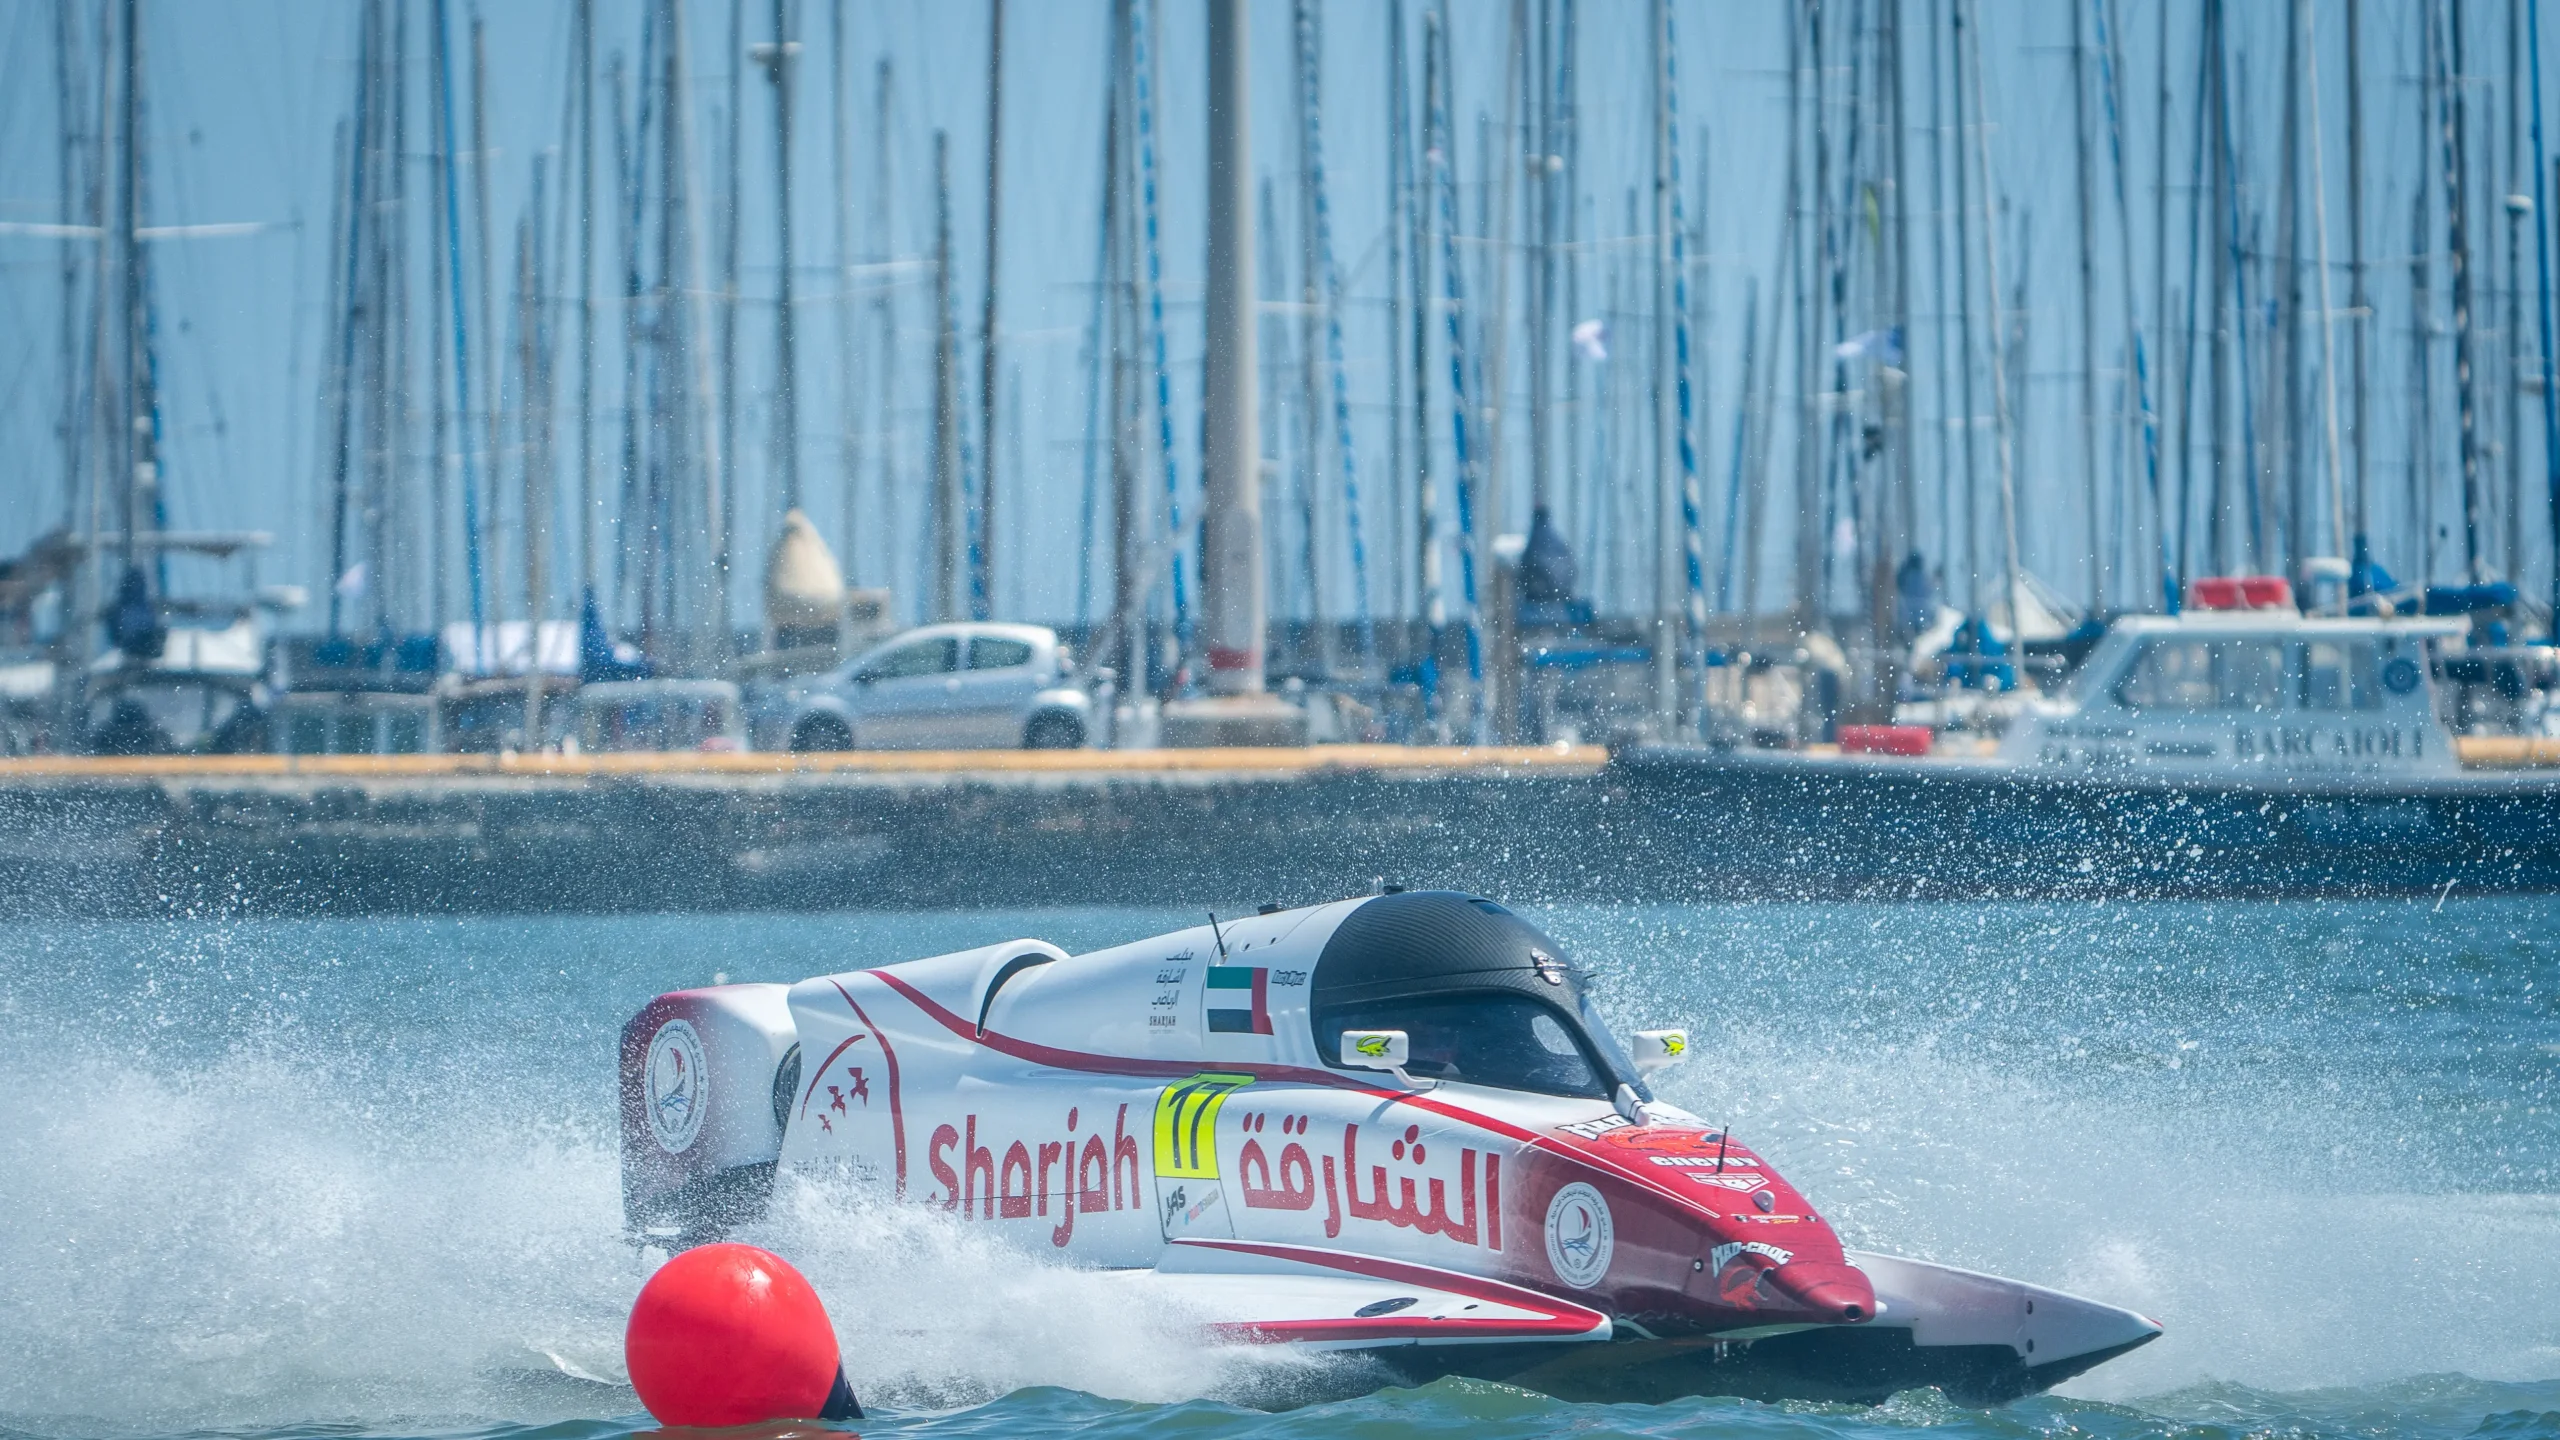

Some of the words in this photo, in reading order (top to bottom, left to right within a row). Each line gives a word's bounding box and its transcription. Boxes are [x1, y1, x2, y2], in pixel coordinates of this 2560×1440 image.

[2234, 726, 2424, 760] BARCAIOLI
[1149, 1015, 1177, 1028] SHARJAH
[1168, 1081, 1240, 1170] 17
[925, 1103, 1142, 1248] Sharjah
[1239, 1112, 1502, 1252] الشارقة
[1710, 1241, 1795, 1278] MAD-CROC
